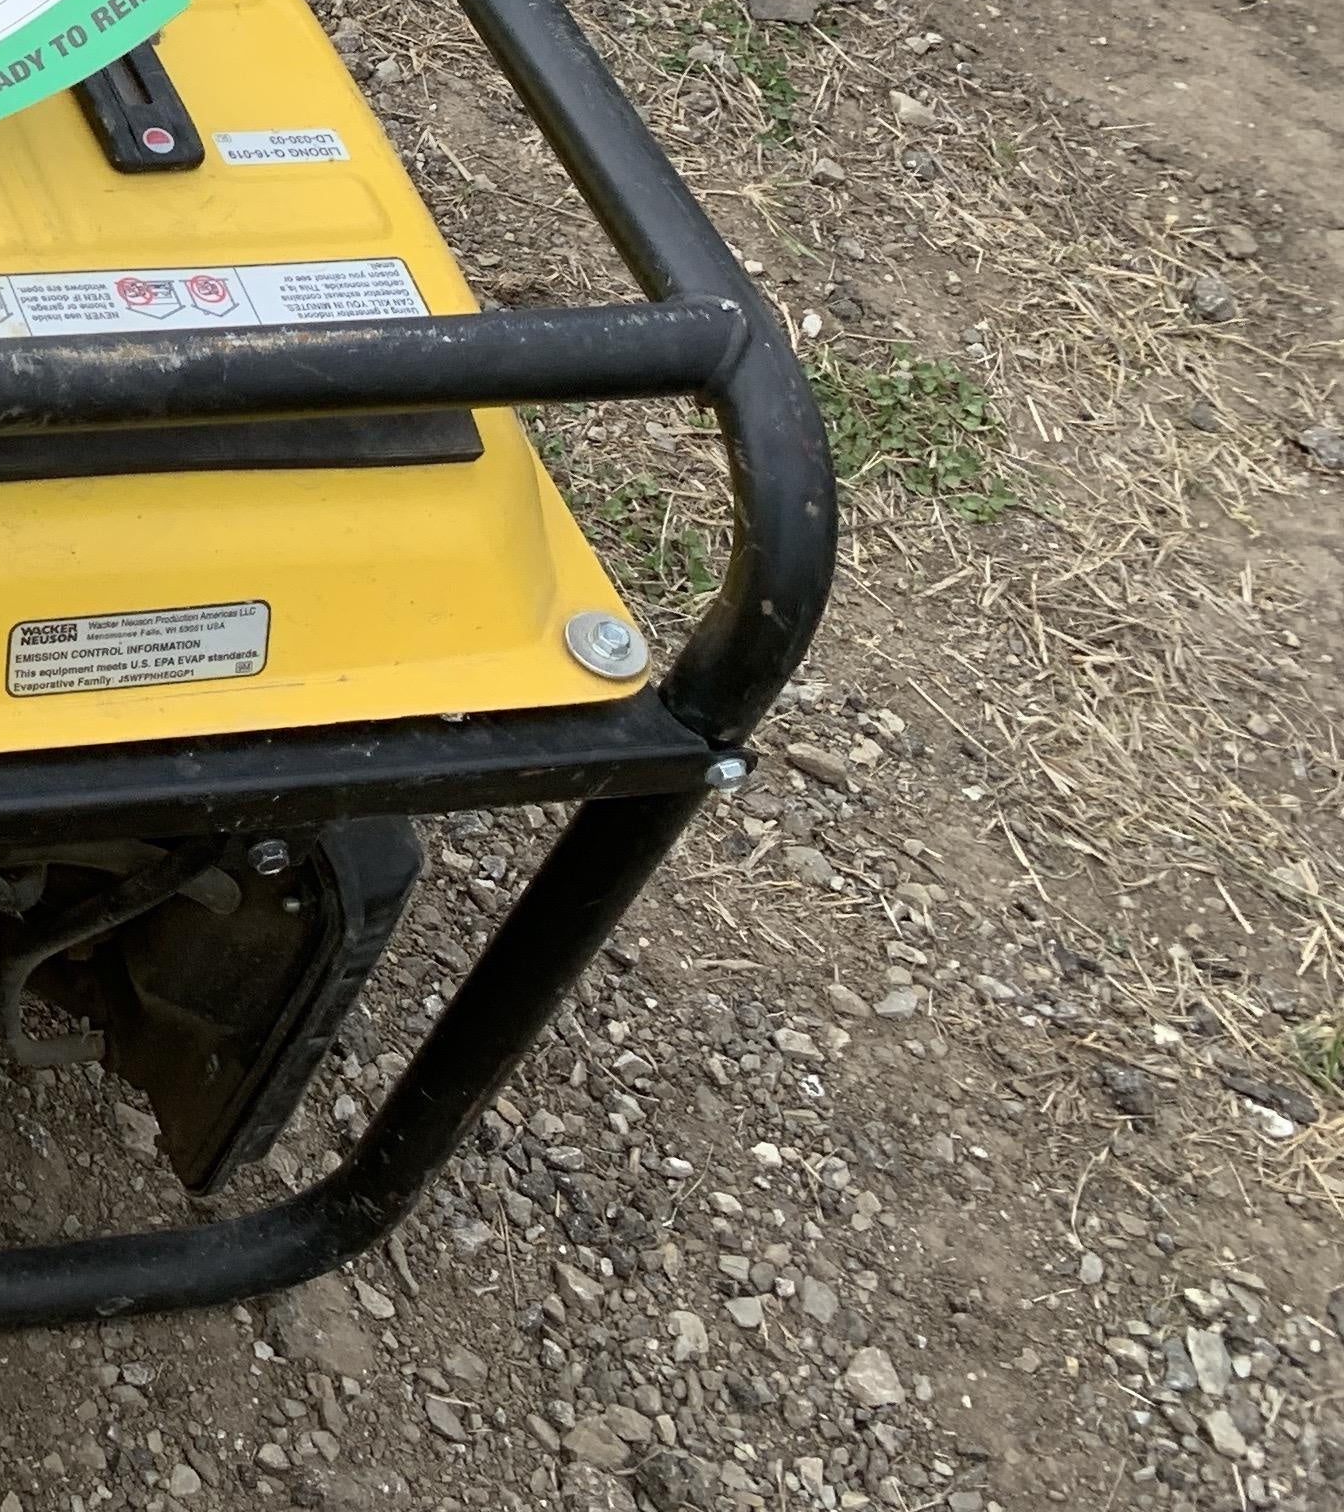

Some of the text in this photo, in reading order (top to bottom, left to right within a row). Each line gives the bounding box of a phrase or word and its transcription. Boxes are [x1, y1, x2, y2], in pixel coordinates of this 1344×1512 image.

[49, 25, 88, 57] TO
[288, 147, 341, 157] LIDONG
[87, 606, 255, 631] Wacker Neuson Production Americas LLC
[206, 621, 224, 631] USA
[20, 622, 76, 636] WACKER
[20, 633, 76, 646] NEUSON
[15, 638, 200, 664] EMISSION CONTROL INFORMATION
[14, 668, 35, 678] This
[39, 663, 93, 678] equipment
[96, 660, 127, 671] meets
[130, 658, 150, 668] U.S.
[154, 656, 174, 666] EPA
[177, 653, 204, 664] EVAP
[14, 678, 74, 693] Evaporative
